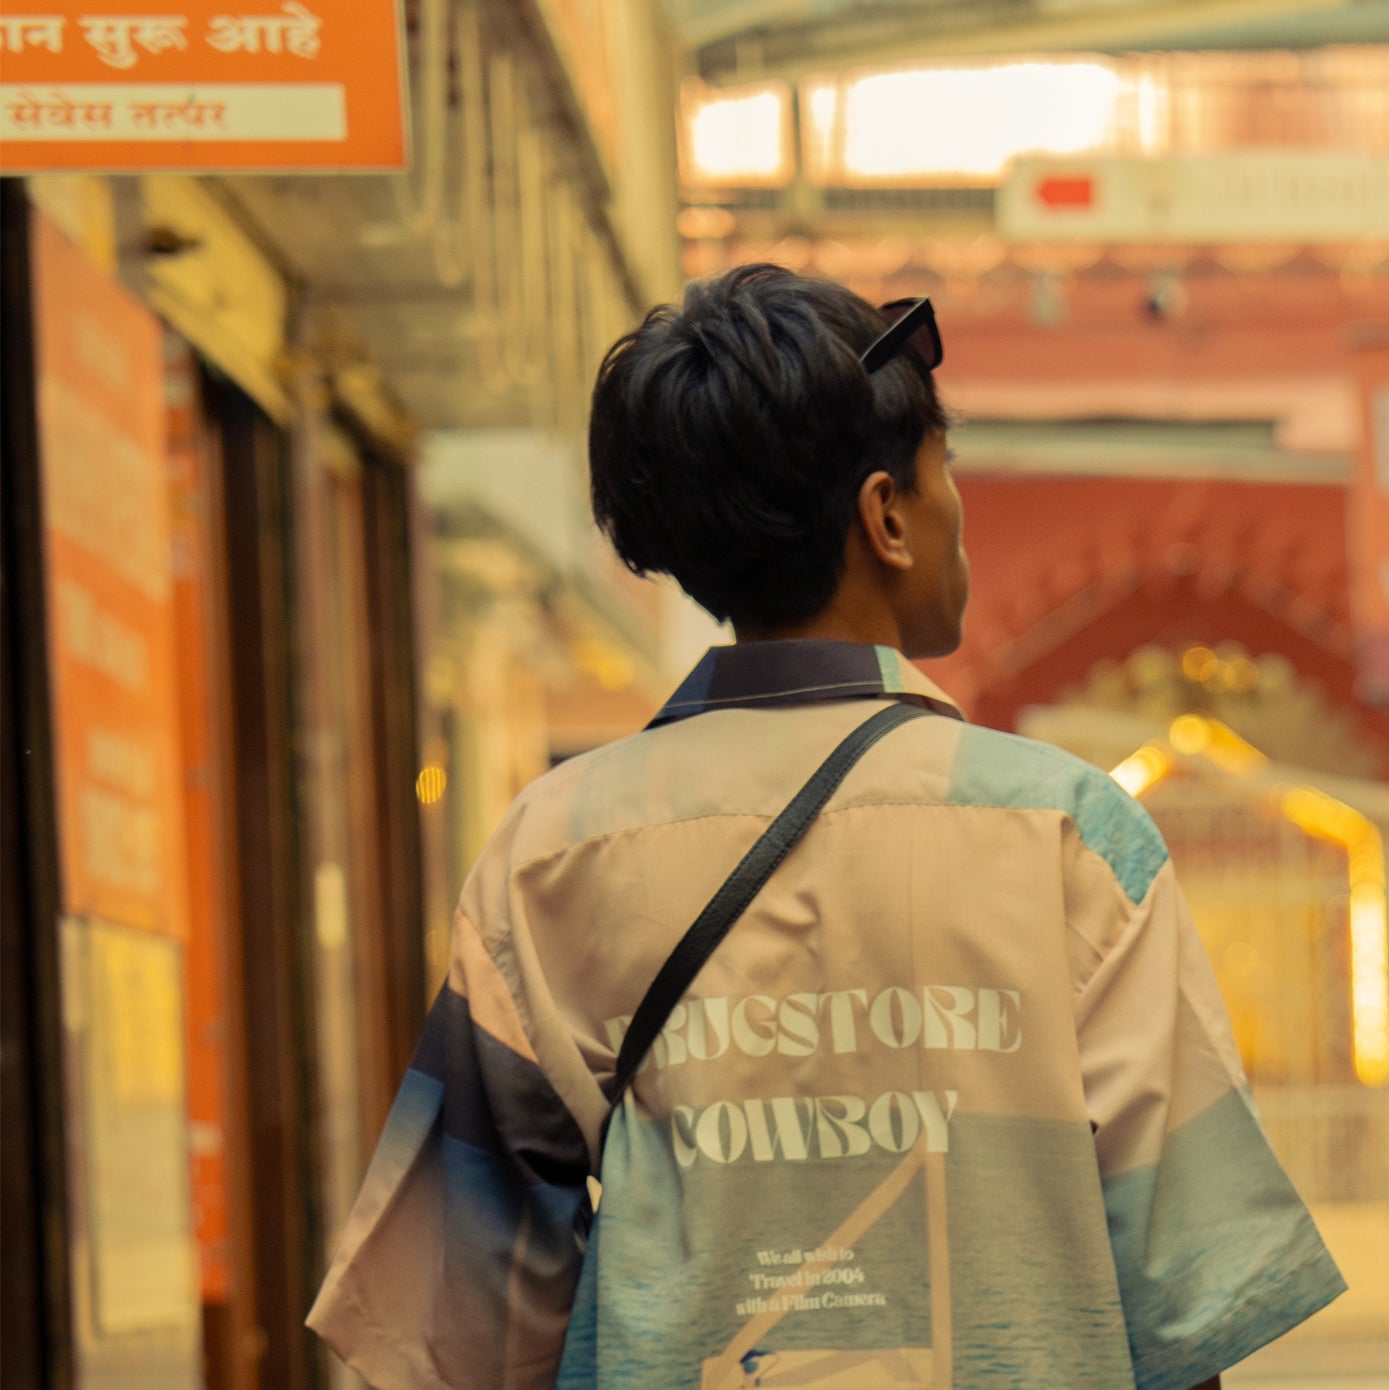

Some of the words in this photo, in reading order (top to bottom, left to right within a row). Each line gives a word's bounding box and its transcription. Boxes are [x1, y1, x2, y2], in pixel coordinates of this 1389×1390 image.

[0, 14, 66, 53] ान
[77, 14, 189, 69] सुरू
[204, 0, 323, 58] आहे
[671, 1090, 957, 1168] COWBOY
[757, 1250, 780, 1265] We
[782, 1250, 802, 1264] all
[804, 1248, 837, 1263] wish
[839, 1249, 855, 1261] to
[749, 1271, 802, 1290] Travel
[805, 1271, 820, 1286] in
[822, 1267, 865, 1285] 2004
[735, 1297, 767, 1316] with
[782, 1294, 820, 1312] Film
[822, 1292, 886, 1309] Camera
